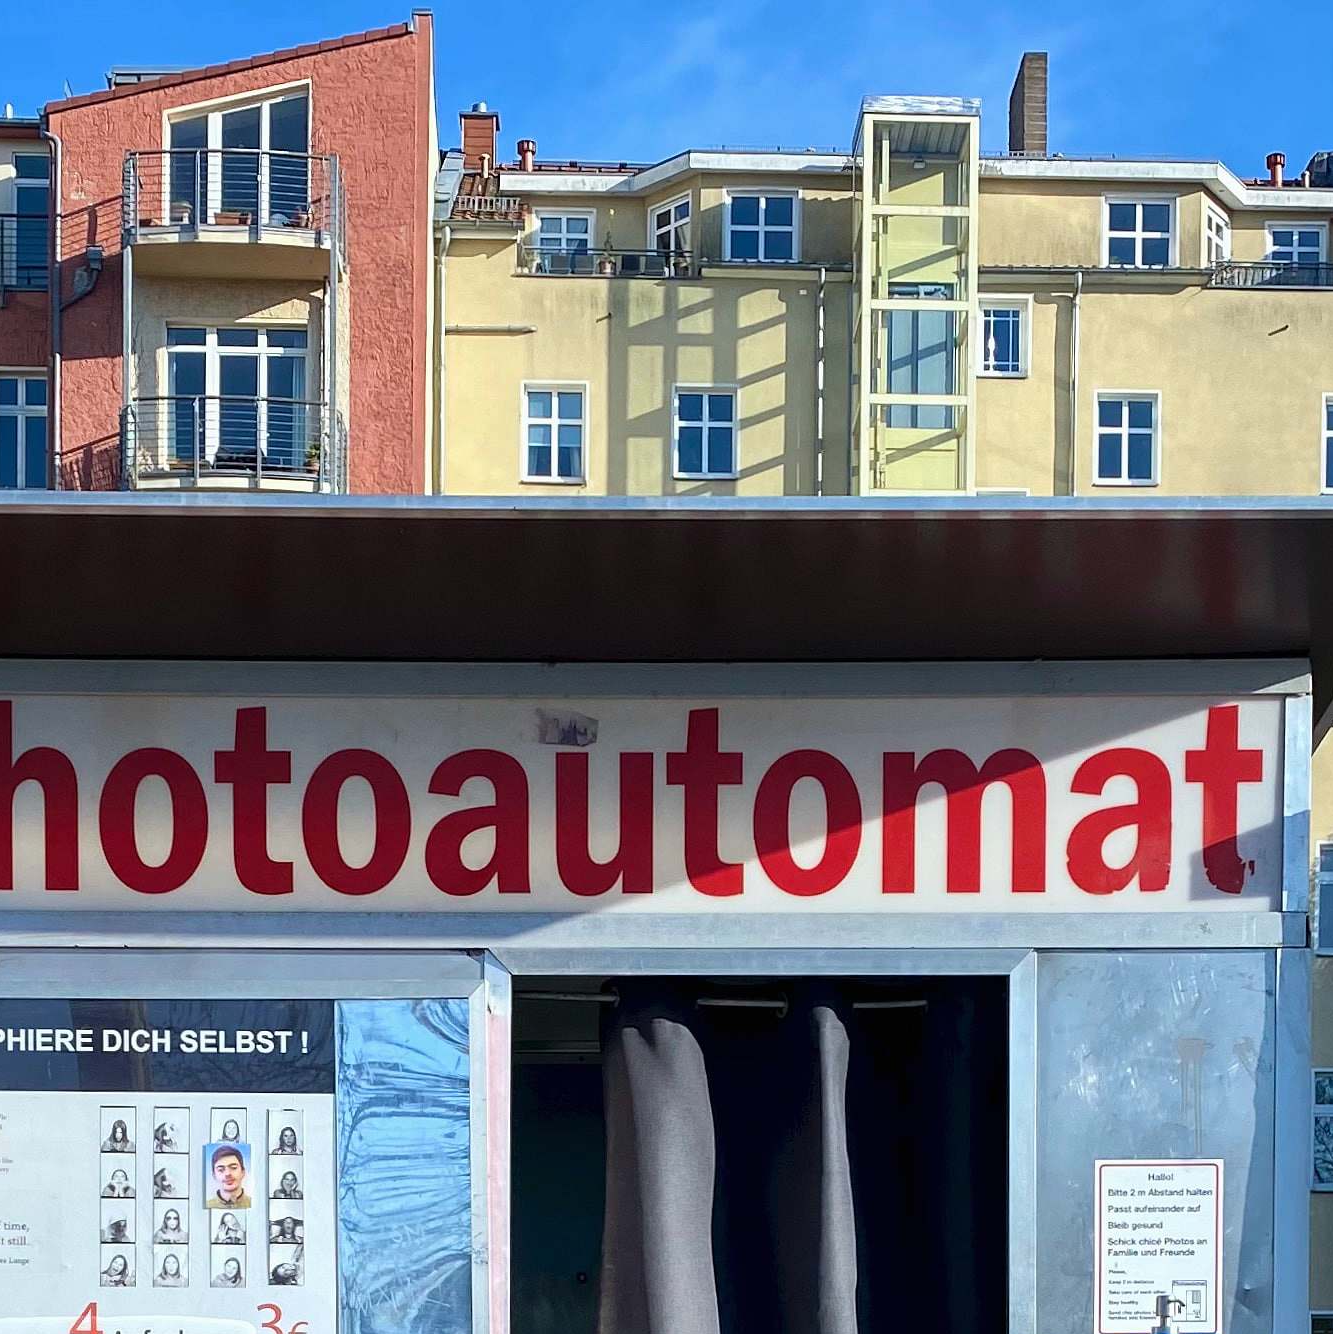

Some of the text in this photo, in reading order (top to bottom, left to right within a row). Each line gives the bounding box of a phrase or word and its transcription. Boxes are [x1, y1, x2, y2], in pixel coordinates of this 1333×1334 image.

[102, 1029, 171, 1052] DICH
[179, 1030, 293, 1053] SELBST
[1108, 1189, 1213, 1197] Bitte 2 m Abstand halten
[1108, 1204, 1201, 1213] Passt aufeinander auf
[4, 1221, 30, 1232] time,
